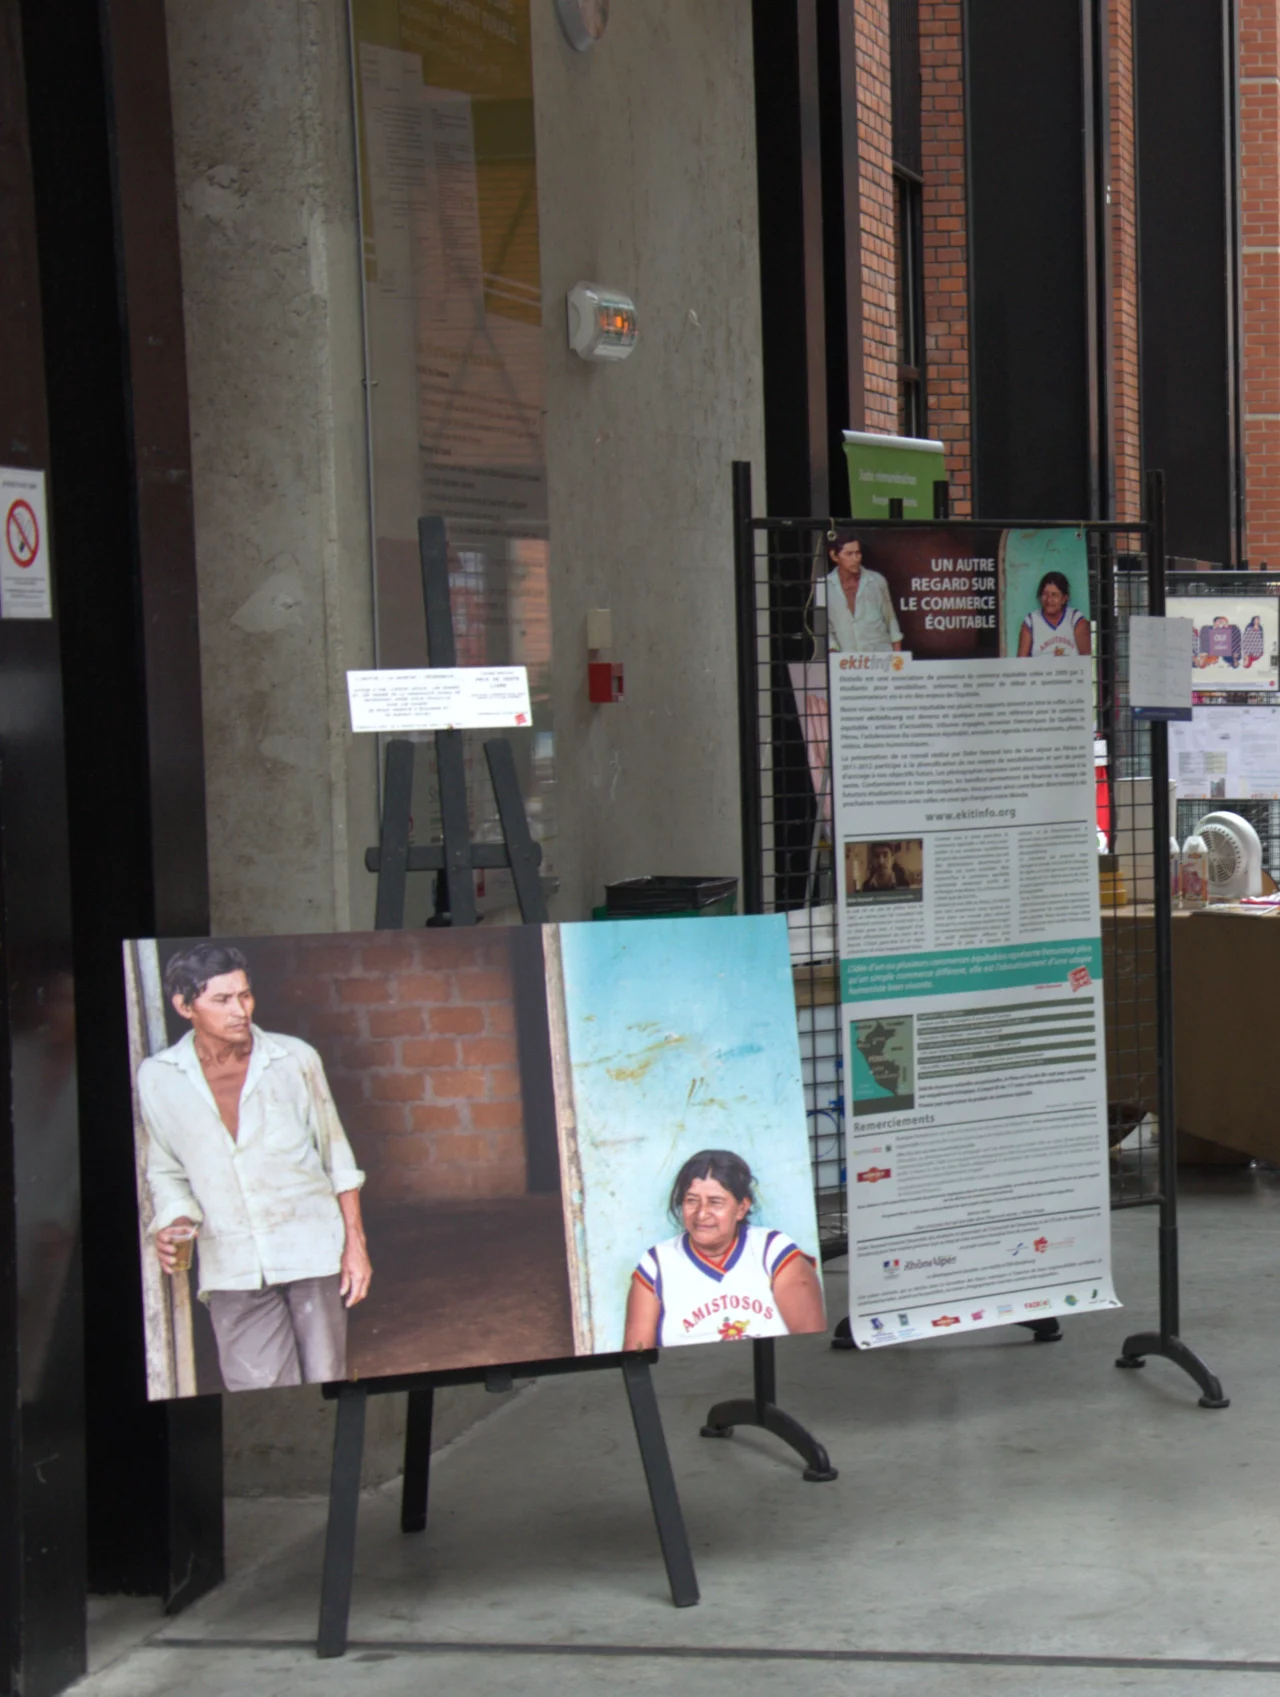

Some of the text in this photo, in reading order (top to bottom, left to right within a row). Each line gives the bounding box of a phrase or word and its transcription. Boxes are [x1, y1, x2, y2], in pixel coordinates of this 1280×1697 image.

[931, 558, 995, 572] UN AUTRE
[911, 577, 995, 592] REGARD SUR
[900, 596, 996, 611] LE COMMERCE
[925, 613, 996, 631] ÉQUITABLE
[926, 807, 1016, 822] www.ekitinfo.org
[853, 1114, 936, 1133] Remerciements
[680, 1294, 775, 1334] AMISTOSOS
